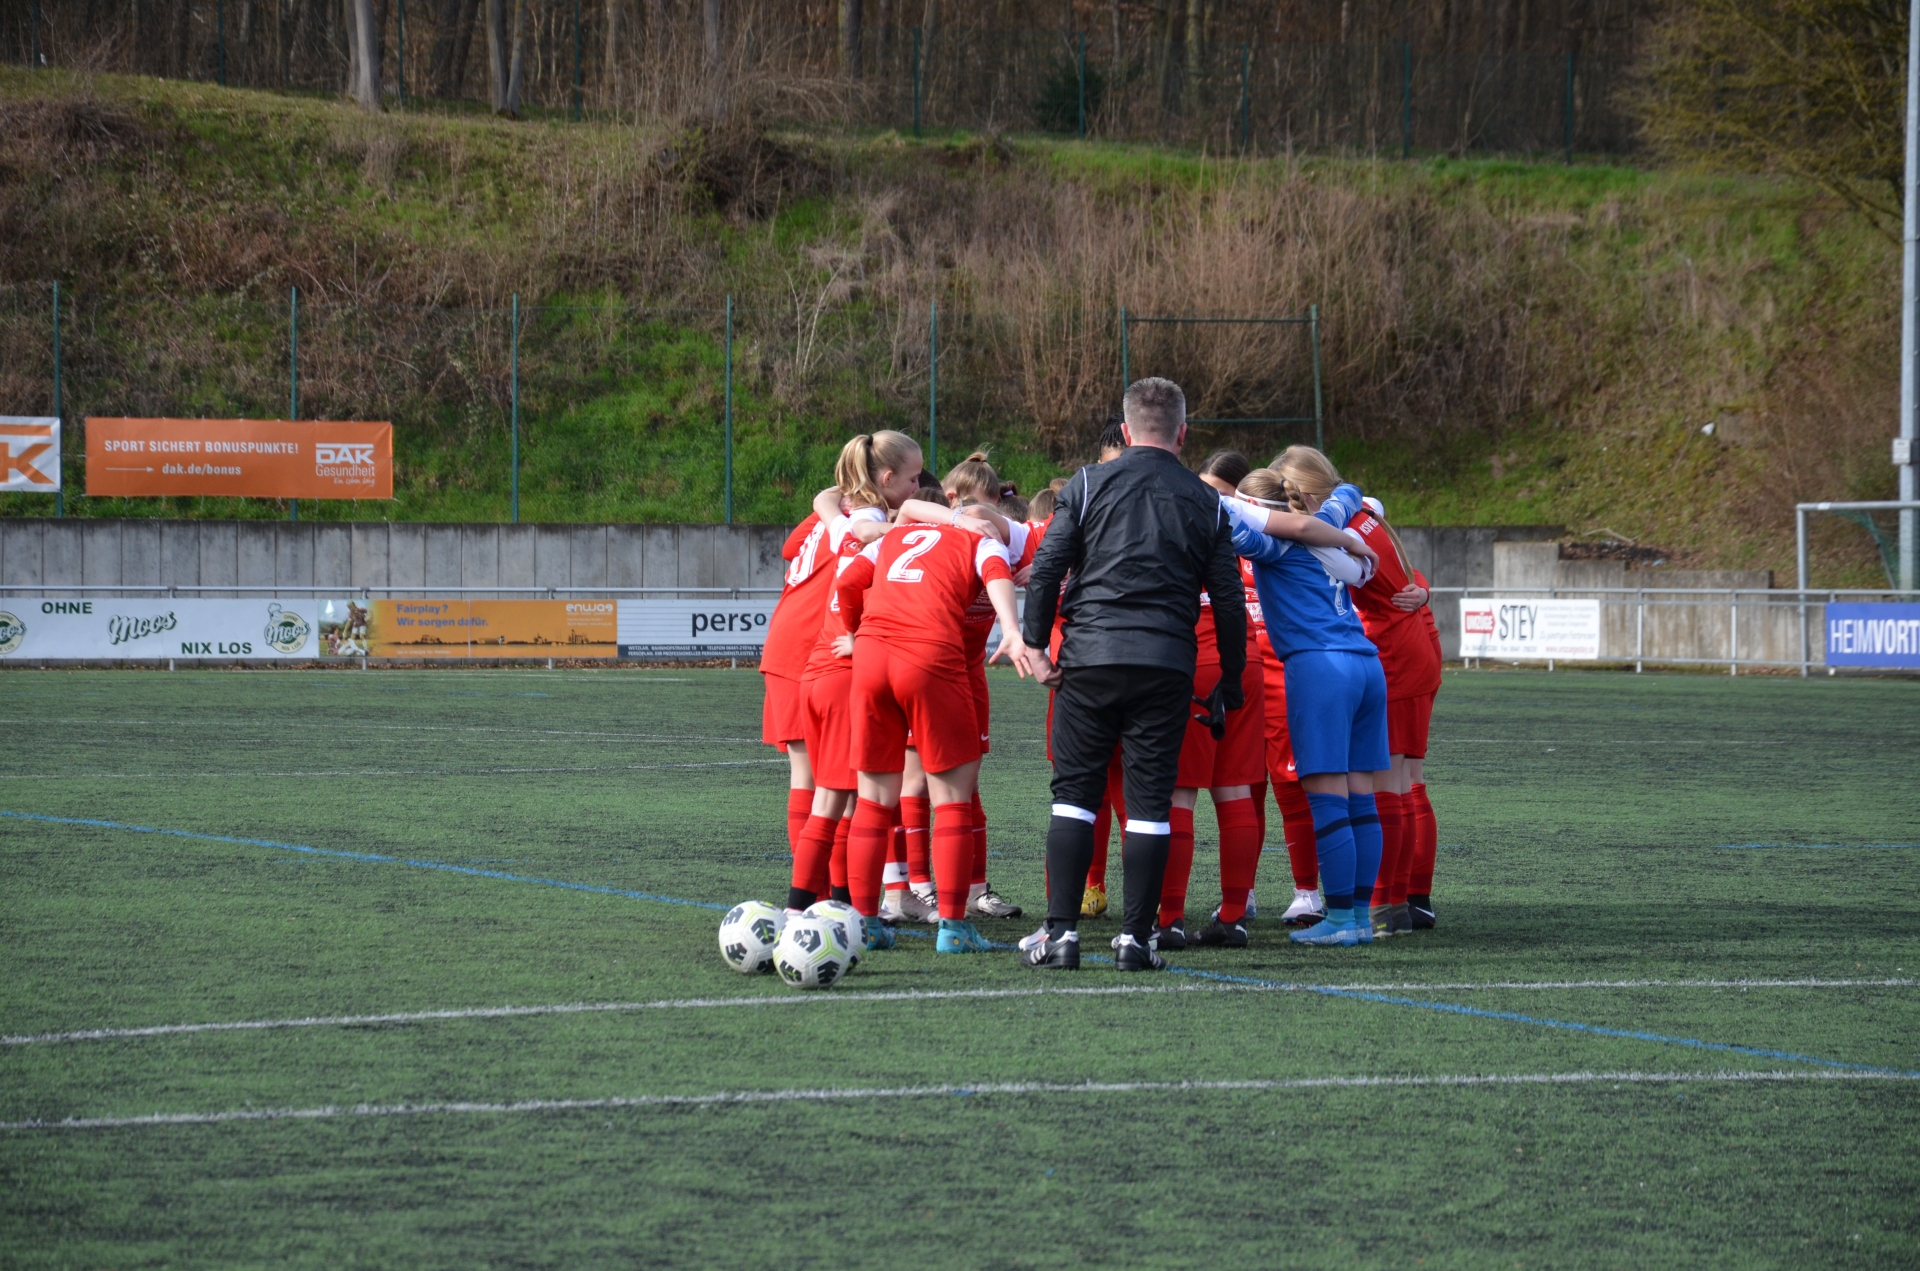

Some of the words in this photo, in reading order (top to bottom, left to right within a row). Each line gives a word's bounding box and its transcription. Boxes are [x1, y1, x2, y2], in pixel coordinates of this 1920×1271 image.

[104, 440, 145, 452] SPORT
[149, 440, 201, 453] SICHERT
[205, 441, 299, 454] BONUSPUNKTE!
[315, 443, 375, 464] DAK
[162, 463, 242, 475] dak.de/bonus
[315, 463, 375, 477] Gesundheit
[887, 529, 942, 582] 2
[41, 601, 93, 614] OHNE
[397, 604, 441, 615] Fairplay
[107, 610, 177, 645] Moos
[397, 617, 415, 626] Wir
[418, 618, 455, 628] sorgen
[457, 617, 488, 627] dafür.
[692, 613, 768, 638] perso
[1499, 604, 1538, 641] STEY
[1830, 618, 1920, 655] HEIMVORT
[181, 642, 213, 655] NIX
[218, 642, 252, 655] LOS
